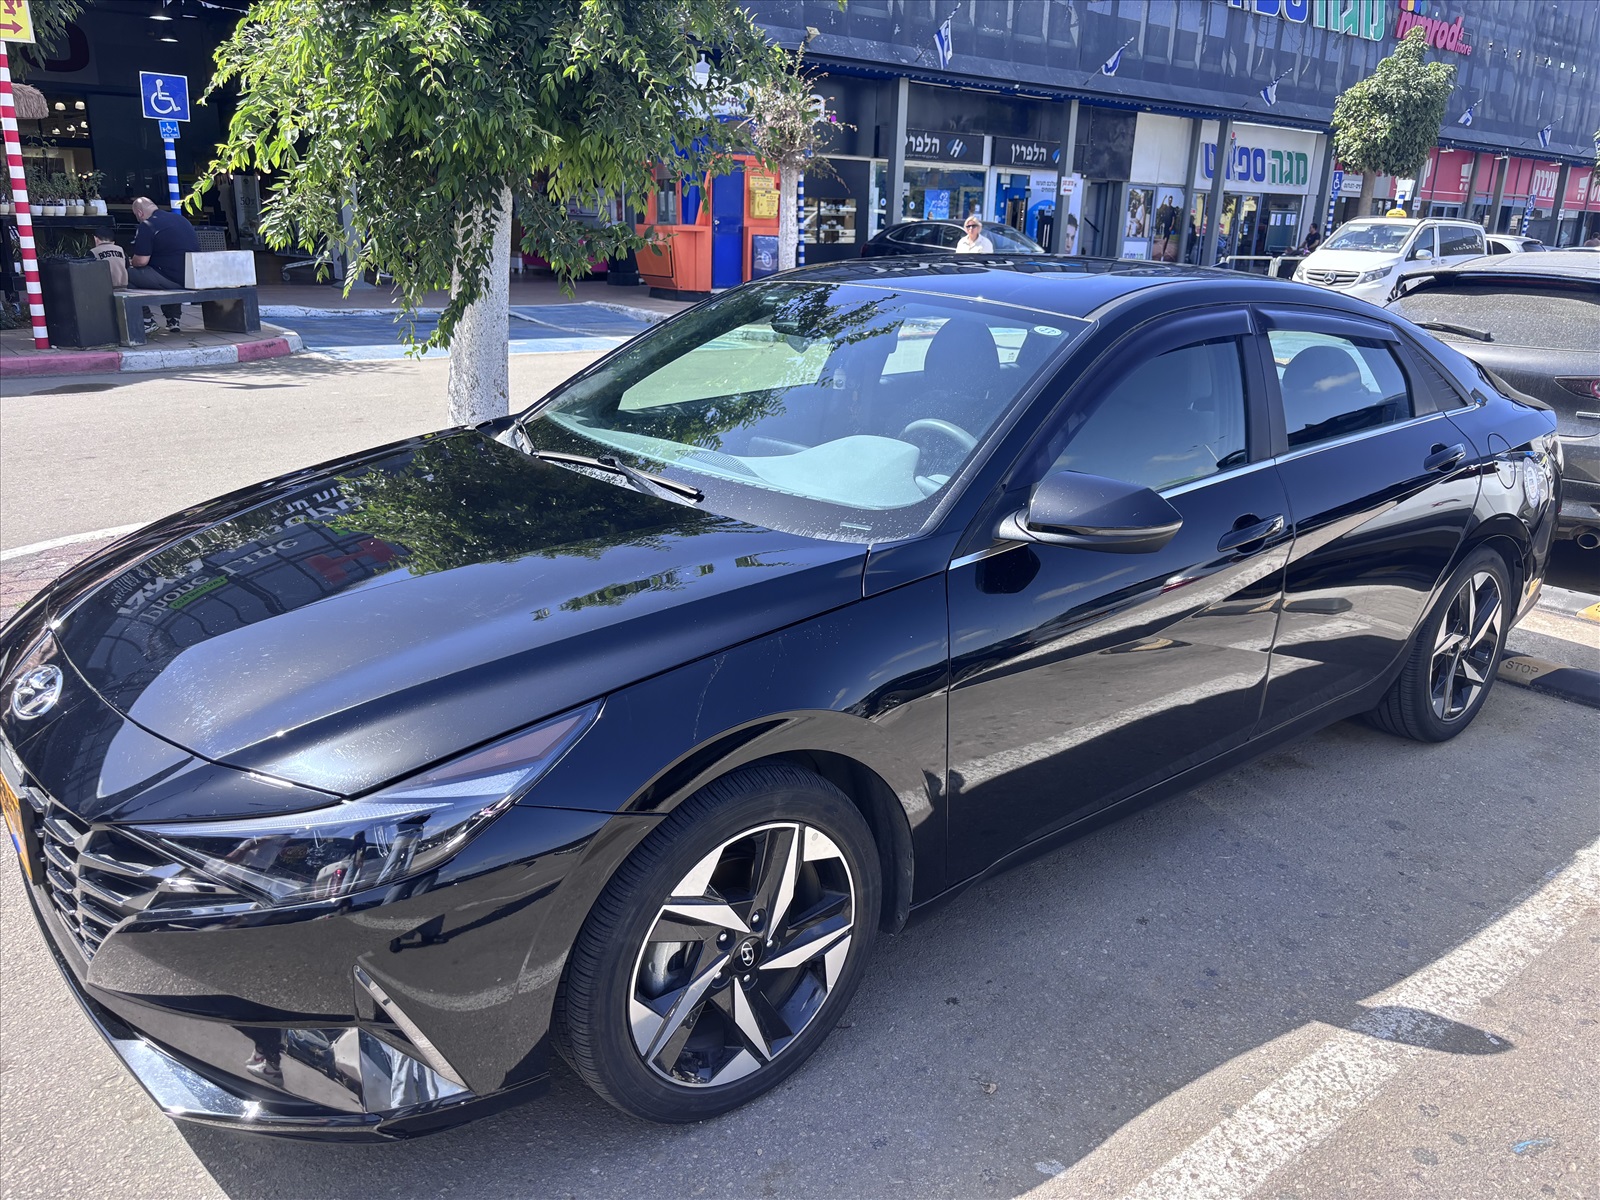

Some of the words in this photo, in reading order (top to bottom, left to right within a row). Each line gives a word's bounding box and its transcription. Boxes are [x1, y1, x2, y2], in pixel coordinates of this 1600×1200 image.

[1011, 142, 1047, 164] הלפרין
[1270, 149, 1308, 185] מגה
[98, 250, 124, 260] BOSTON
[1505, 660, 1539, 675] STOP
